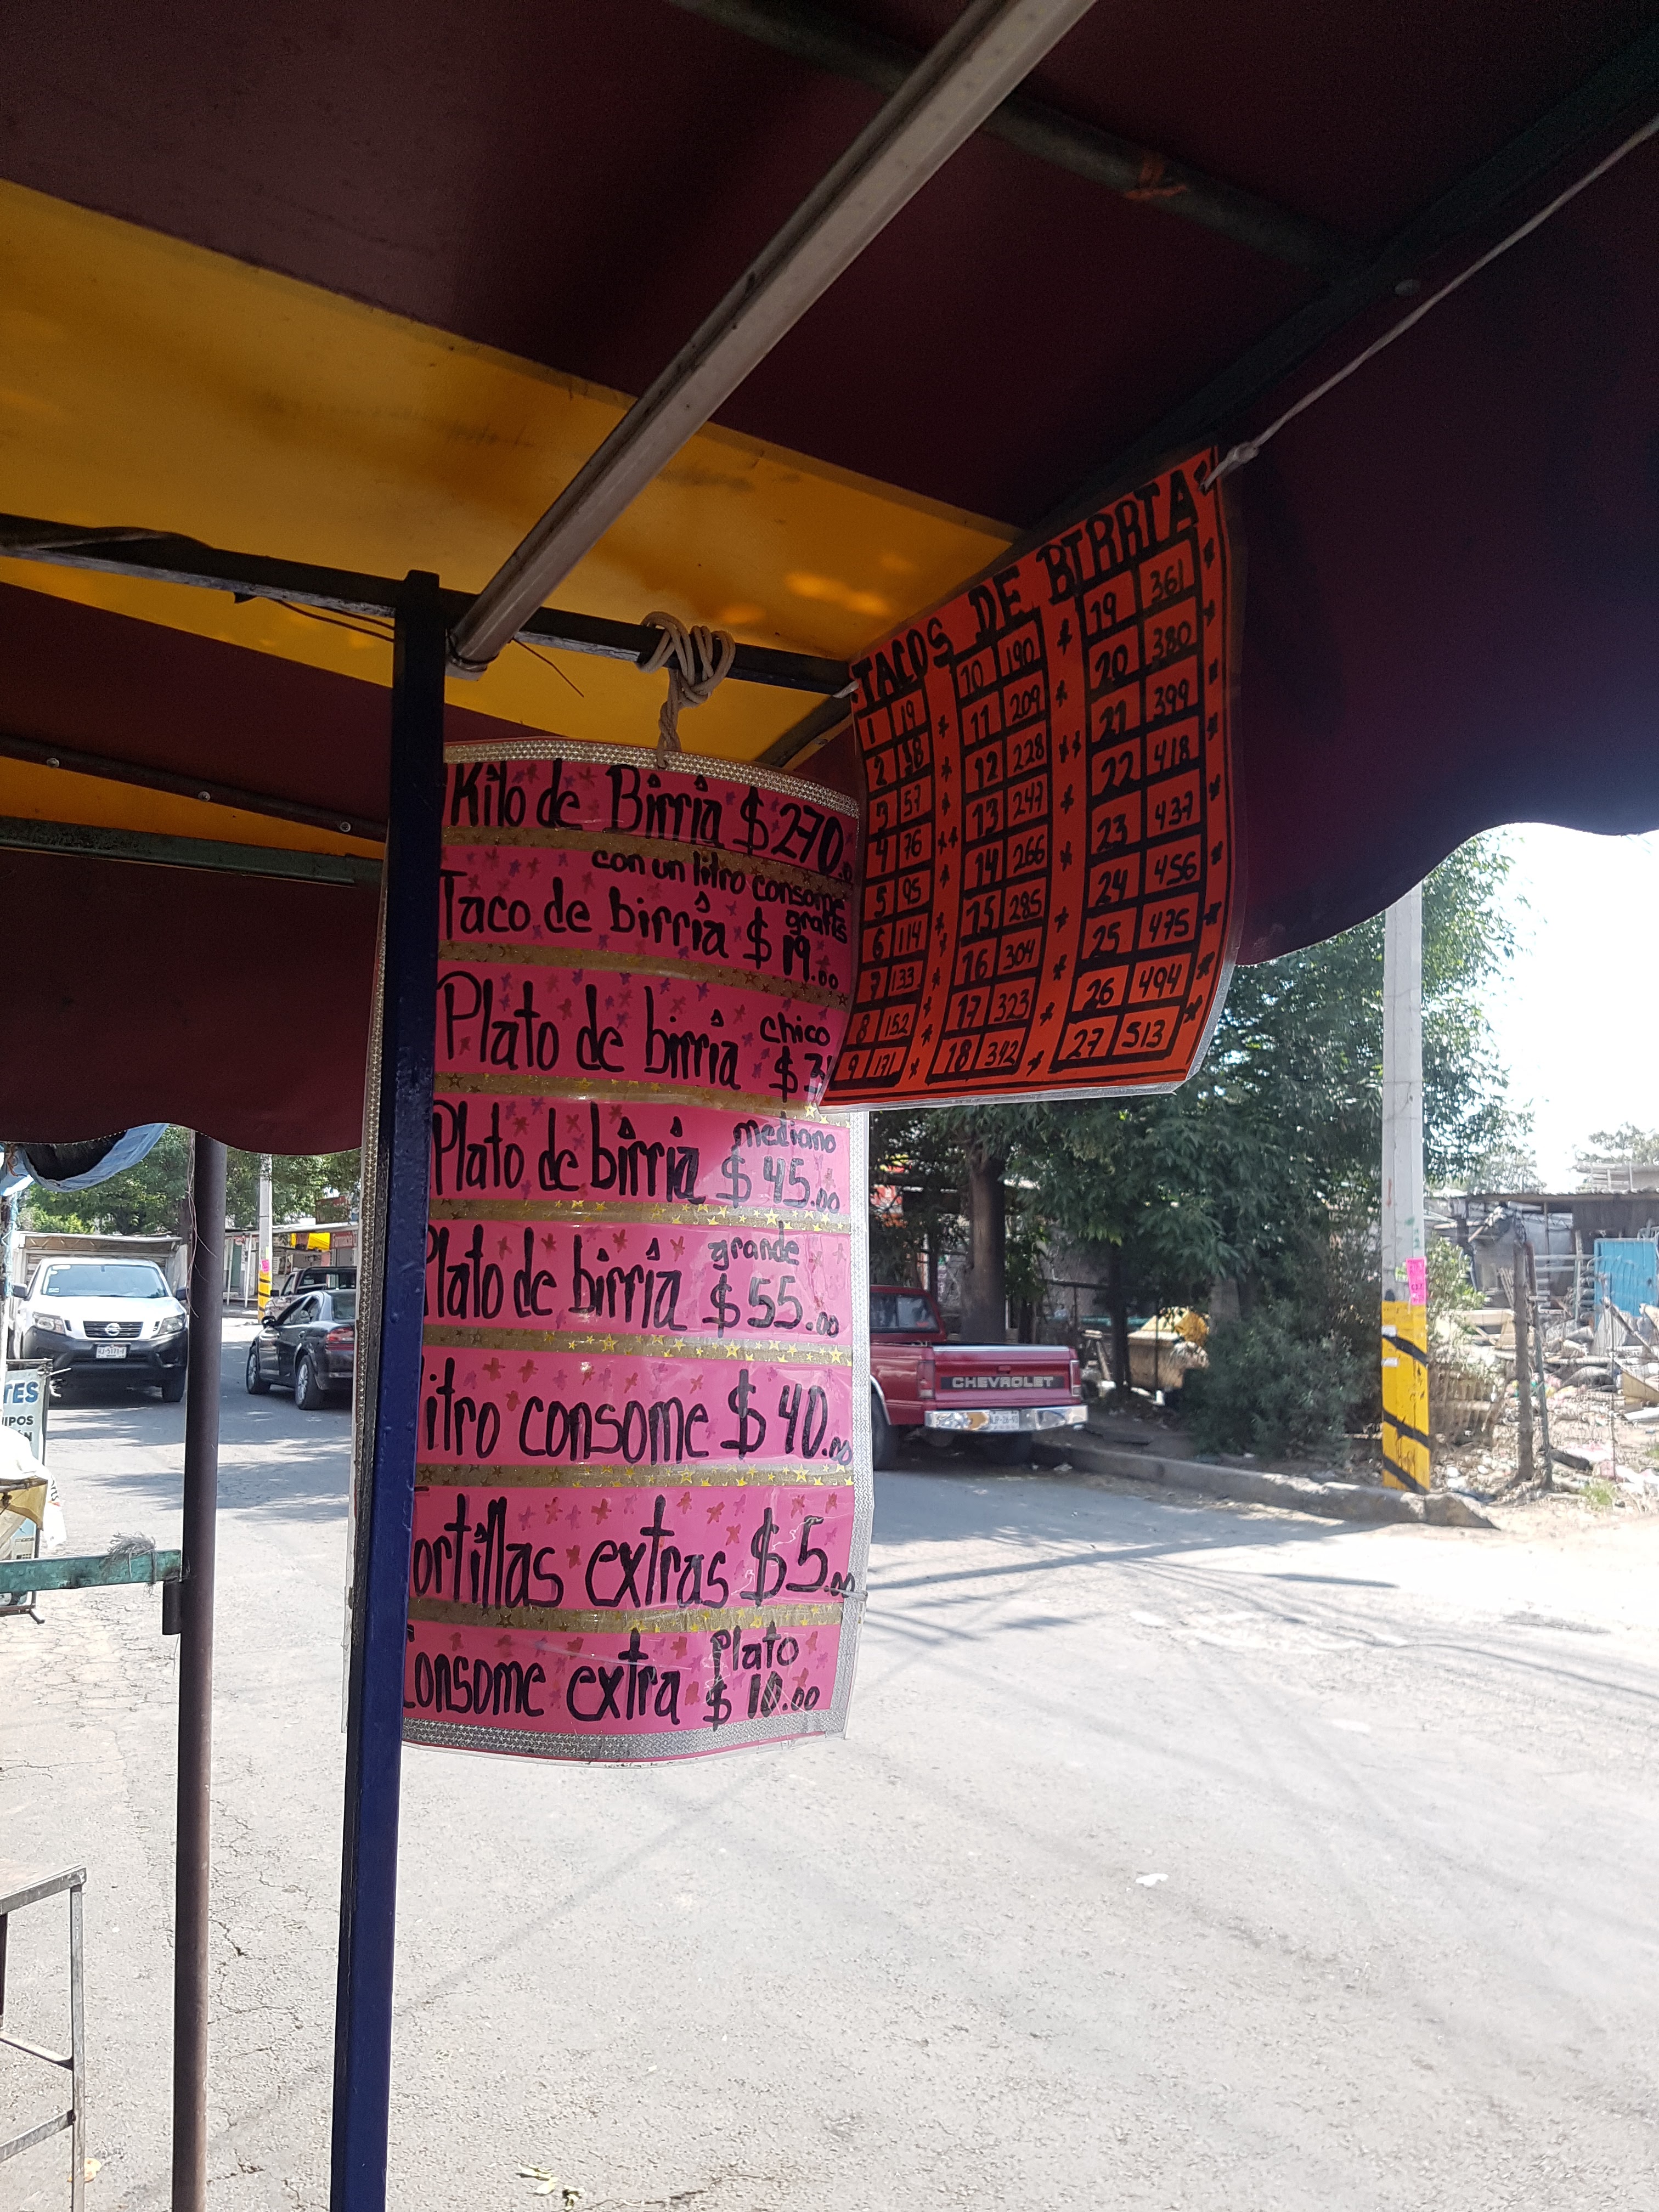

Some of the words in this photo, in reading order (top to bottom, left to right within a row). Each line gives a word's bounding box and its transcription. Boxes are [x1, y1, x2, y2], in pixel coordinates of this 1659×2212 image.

[851, 617, 954, 701] TACOS
[969, 566, 1021, 641] DE
[1036, 471, 1201, 603] BIRRIA
[1091, 592, 1116, 635] 19
[1150, 559, 1185, 603] 361
[960, 659, 984, 697] 10
[1006, 637, 1035, 673] 190
[1096, 645, 1126, 682] 20
[1153, 621, 1192, 657] 380
[901, 702, 915, 730] 19
[972, 704, 989, 738] 11
[1010, 684, 1041, 719] 209
[1099, 699, 1126, 736] 21
[1154, 679, 1190, 712] 399
[874, 756, 887, 786] 2
[975, 752, 998, 788] 12
[1013, 733, 1045, 772] 228
[1102, 752, 1133, 787] 22
[1154, 734, 1189, 773] 418
[452, 763, 526, 828] Kilo
[537, 758, 582, 831] de
[605, 764, 725, 850] Birria
[877, 799, 889, 832] 3
[904, 784, 922, 816] 57
[972, 798, 1000, 837] 13
[1013, 781, 1043, 819] 247
[1099, 814, 1128, 850] 23
[1155, 791, 1194, 829] 437
[876, 838, 887, 872] 4
[904, 829, 923, 860] 76
[975, 848, 999, 887] 14
[1013, 836, 1045, 873] 266
[592, 849, 645, 874] con
[652, 856, 688, 881] un
[693, 851, 745, 893] litro
[752, 876, 846, 915] consome
[875, 887, 887, 918] 5
[902, 876, 922, 905] 95
[1098, 868, 1128, 905] 24
[1155, 854, 1197, 887] 456
[439, 870, 532, 939] Taco
[544, 876, 591, 933] de
[610, 886, 730, 958] birria
[966, 895, 996, 933] 15
[1010, 890, 1041, 921] 285
[1092, 921, 1120, 957] 25
[1150, 909, 1189, 943] 475
[872, 927, 884, 958] 6
[899, 921, 923, 951] 114
[963, 948, 988, 977] 16
[1003, 938, 1034, 970] 304
[869, 972, 881, 1000] 7
[890, 967, 915, 991] 133
[957, 994, 981, 1029] 17
[994, 989, 1029, 1021] 323
[1086, 977, 1114, 1009] 26
[1138, 962, 1182, 996] 494
[439, 972, 558, 1071] Plato
[577, 984, 625, 1073] de
[645, 985, 742, 1091] birria
[760, 1012, 831, 1047] chico
[857, 1014, 870, 1040] 8
[886, 1012, 909, 1036] 152
[1067, 1029, 1102, 1059] 27
[1120, 1018, 1165, 1049] 513
[849, 1053, 860, 1077] 9
[873, 1053, 896, 1076] 171
[947, 1039, 973, 1071] 18
[985, 1040, 1019, 1066] 342
[433, 1100, 525, 1195] Plato
[539, 1108, 580, 1192] de
[591, 1101, 706, 1205] birria
[733, 1110, 837, 1154] mediano
[707, 1221, 799, 1271] grande
[514, 1227, 556, 1317] de
[568, 1233, 687, 1330] birria
[952, 1376, 1054, 1388] CHEVROLET
[2, 1415, 33, 1426] IPOS
[421, 1357, 500, 1458] itro
[519, 1396, 708, 1465] consome
[413, 1485, 563, 1609] ortillas
[585, 1495, 730, 1609] extras
[712, 1621, 799, 1677] Plato
[567, 1628, 681, 1725] extra
